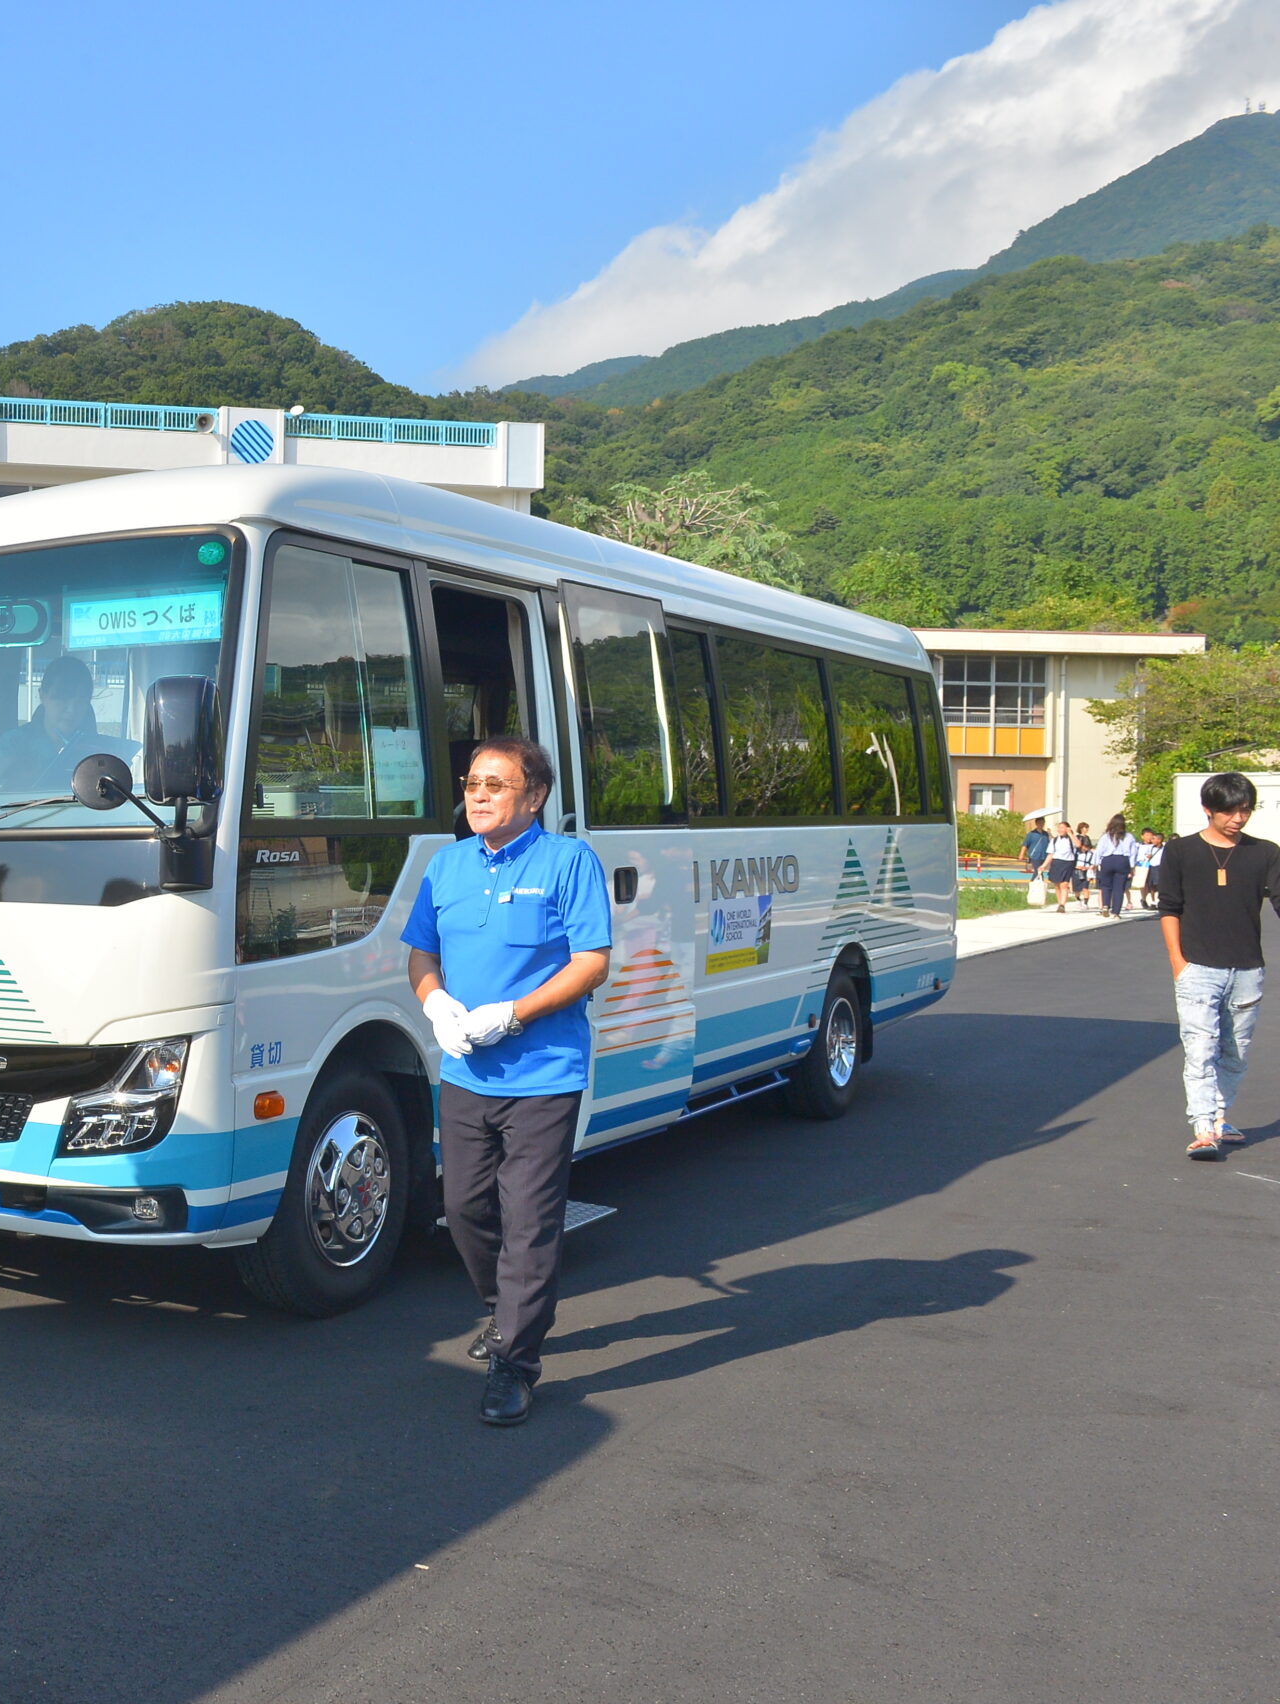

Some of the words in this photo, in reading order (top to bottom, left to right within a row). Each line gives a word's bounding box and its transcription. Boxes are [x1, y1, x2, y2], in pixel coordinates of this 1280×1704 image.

[98, 610, 137, 631] OWIS
[142, 603, 196, 626] つくば
[710, 855, 800, 901] KANKO
[250, 1041, 282, 1069] 貸切
